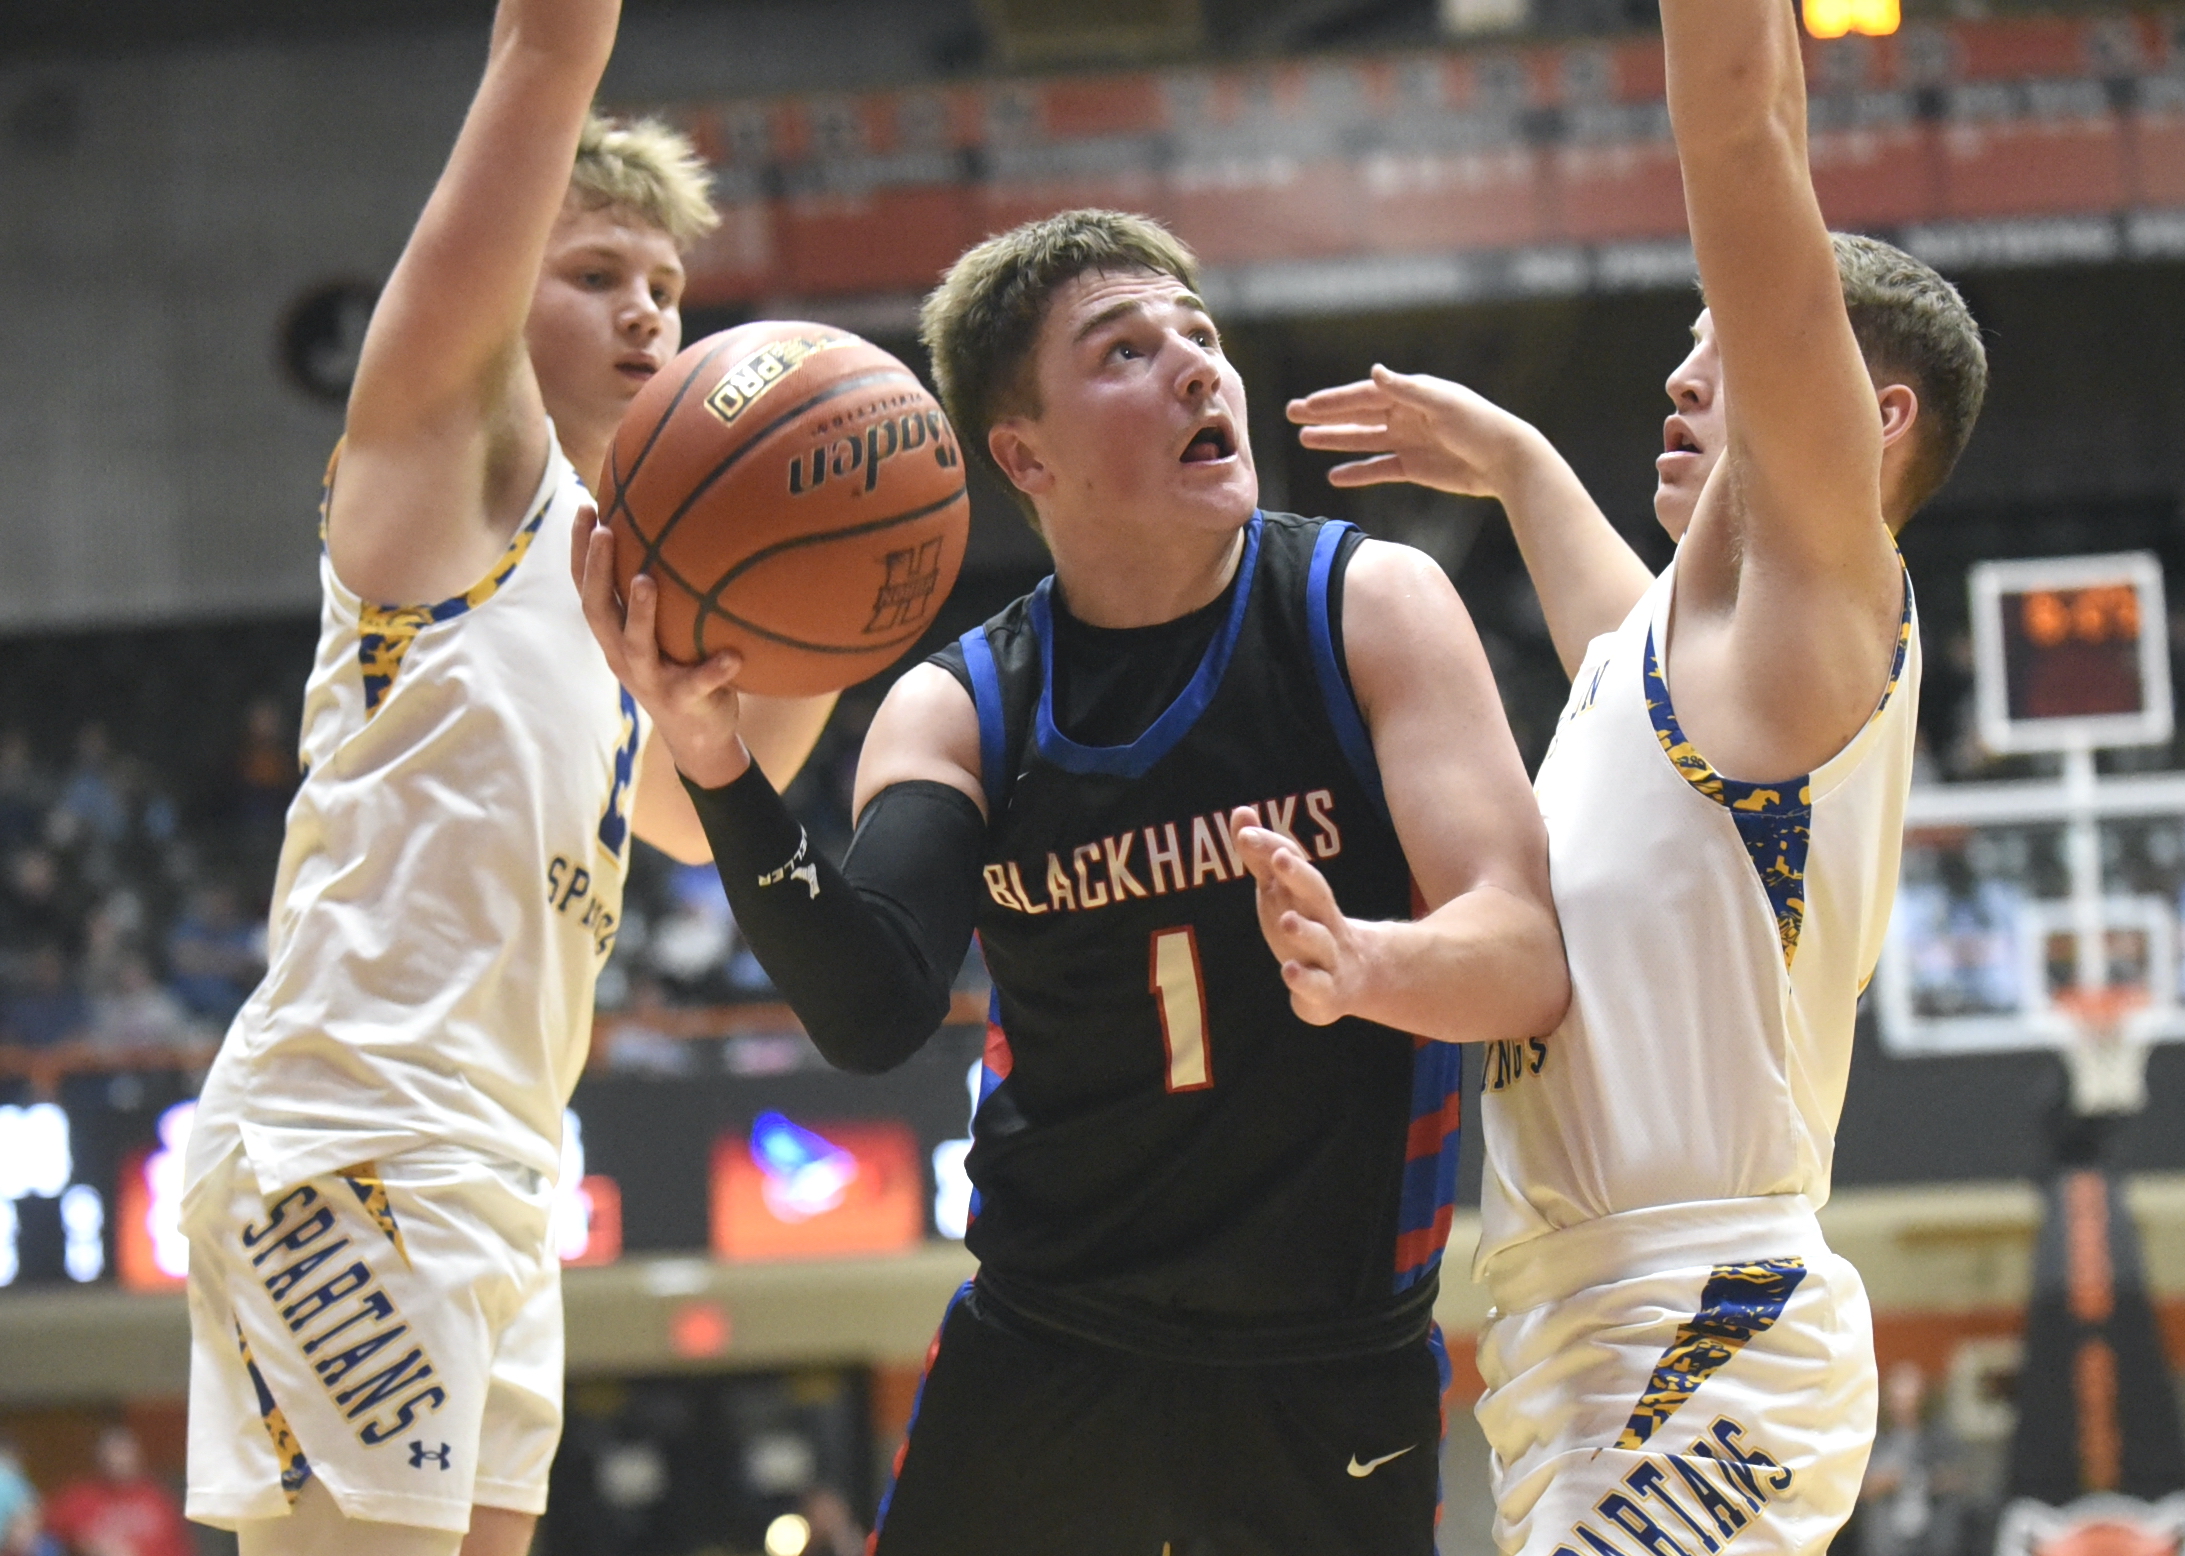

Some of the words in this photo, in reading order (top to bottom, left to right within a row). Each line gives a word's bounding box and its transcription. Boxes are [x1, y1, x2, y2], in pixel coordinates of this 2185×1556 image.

[712, 350, 785, 420] PRO
[788, 410, 958, 496] Baden
[1149, 924, 1214, 1094] 1
[239, 1181, 449, 1449] SPARTANS
[1551, 1415, 1795, 1556] RTANS
